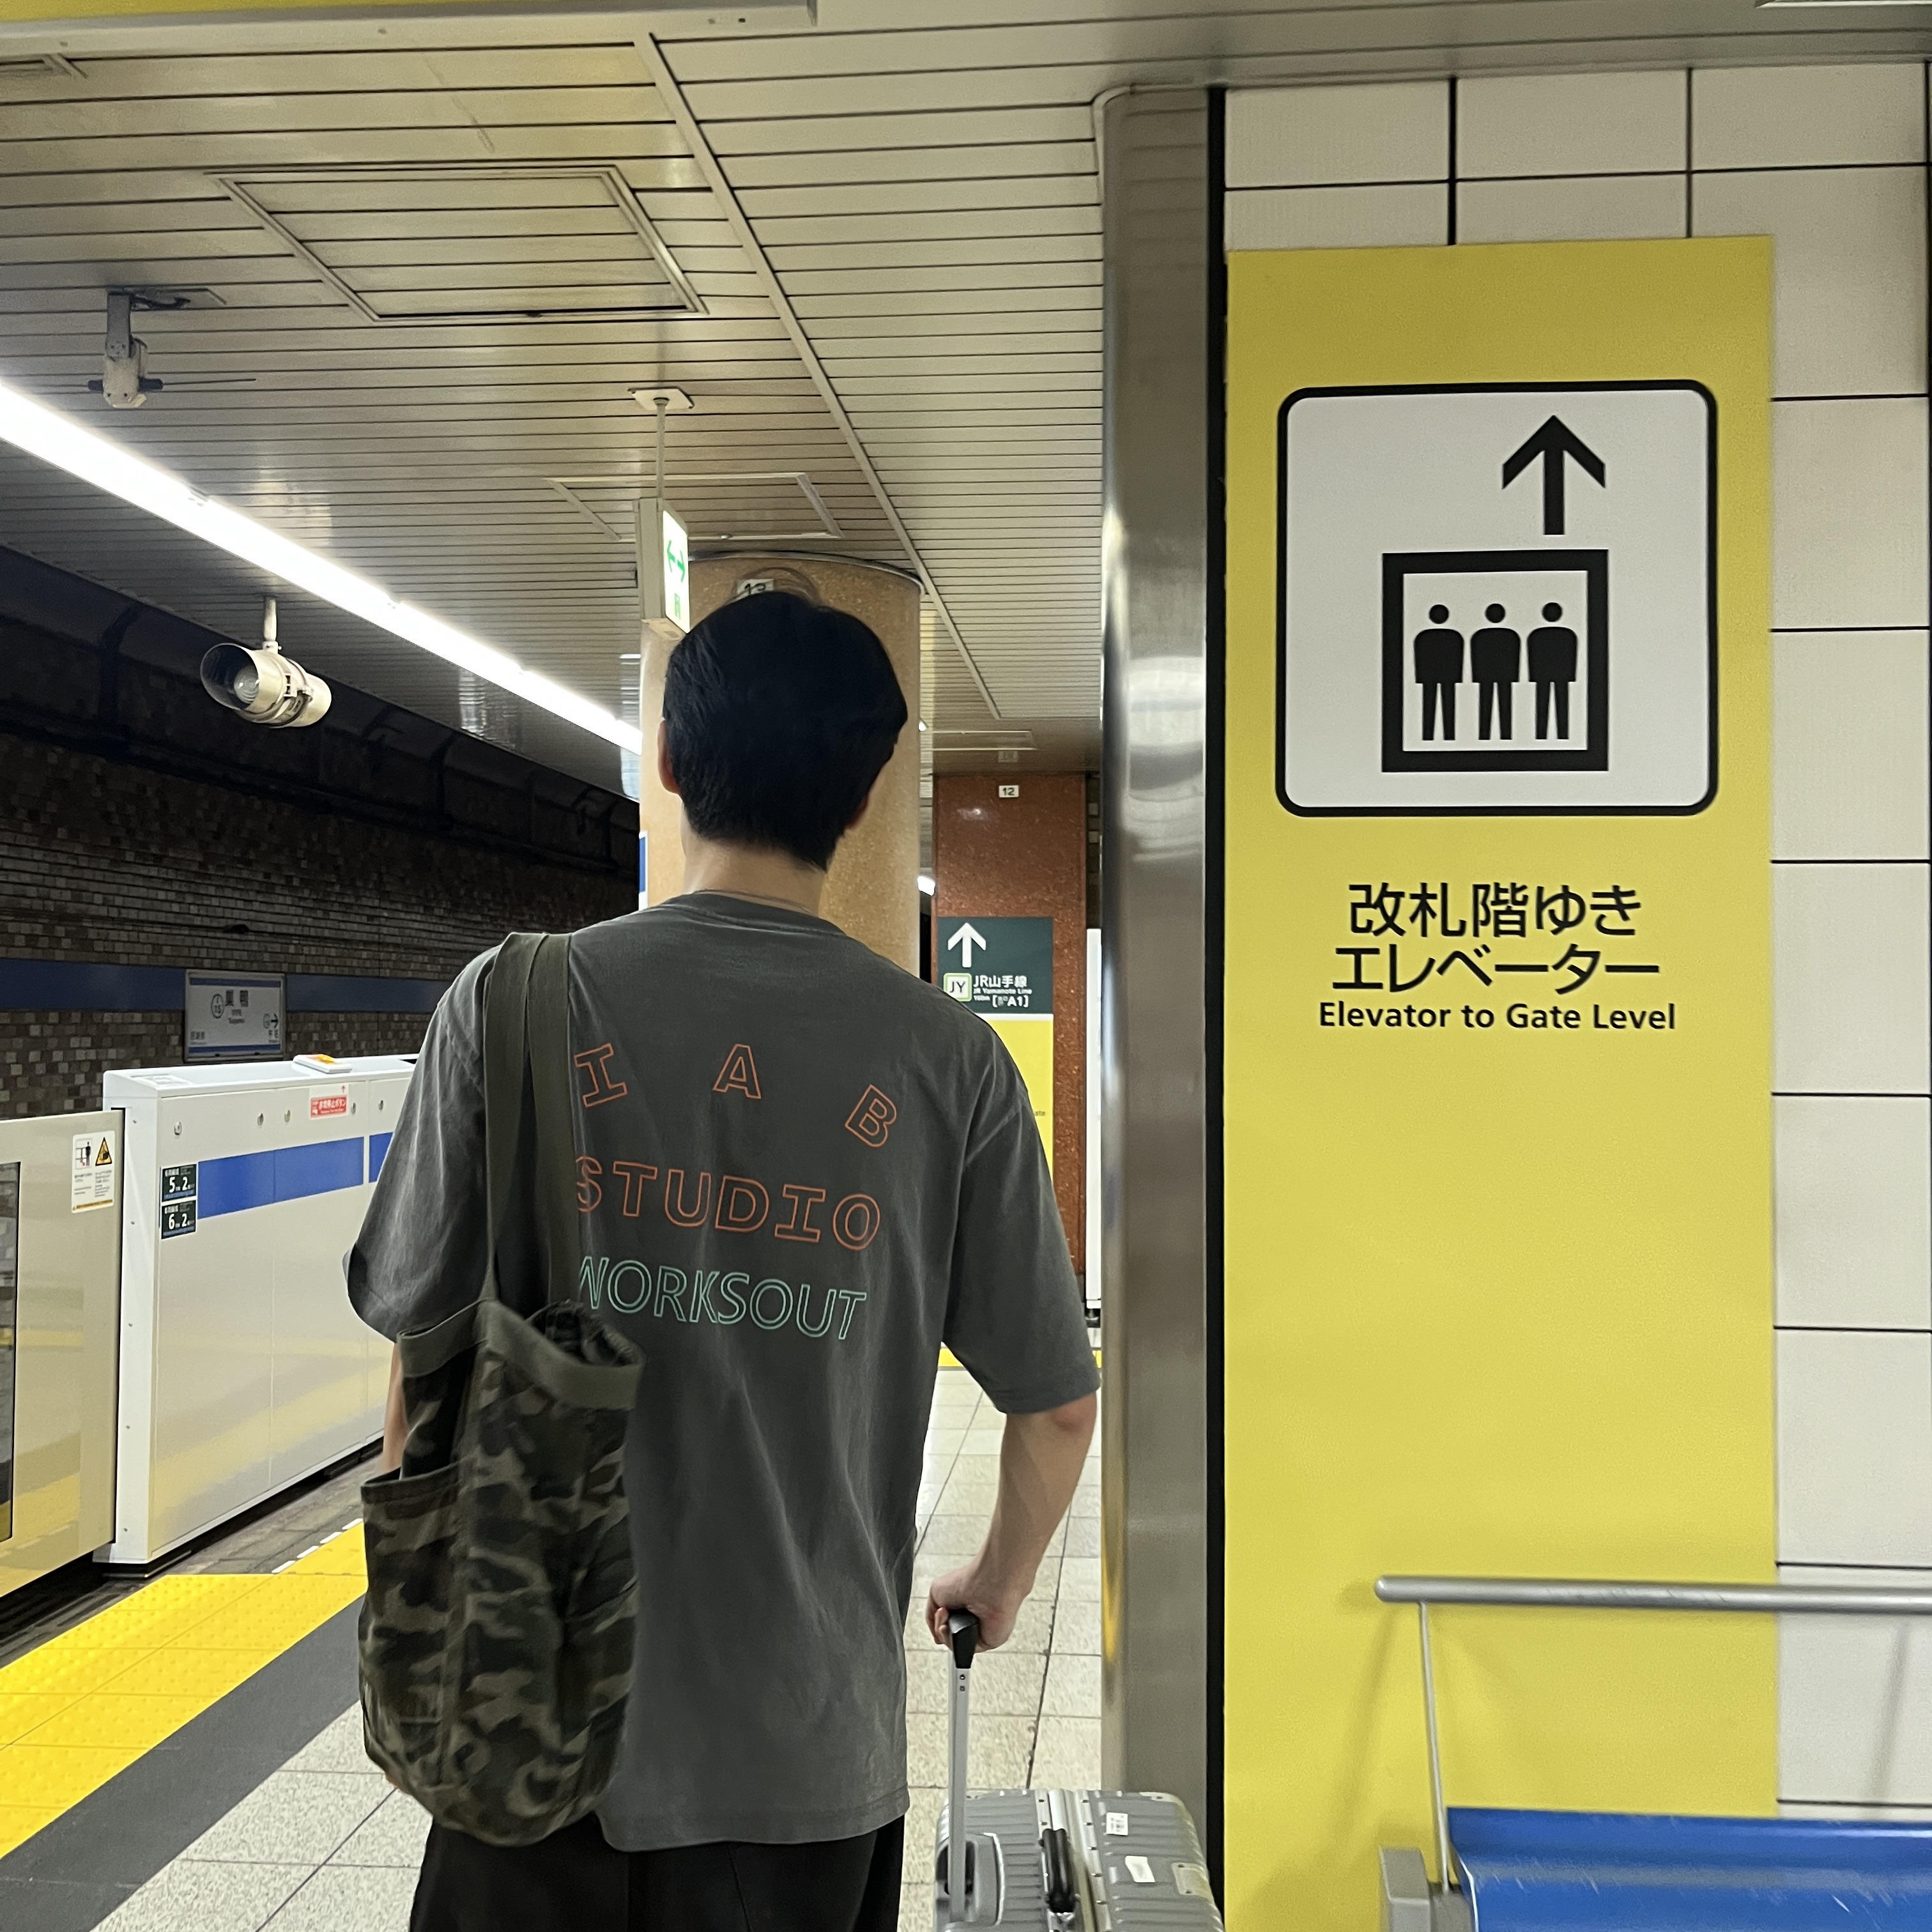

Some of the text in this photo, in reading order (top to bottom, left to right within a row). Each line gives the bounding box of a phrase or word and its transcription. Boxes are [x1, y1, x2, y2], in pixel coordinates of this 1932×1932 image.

[1002, 787, 1015, 796] 12
[1348, 882, 1641, 938] 改札階ゆき
[1332, 943, 1660, 995] エレベーター
[949, 981, 966, 993] JY
[1320, 1001, 1675, 1030] Elevator to Gate Level
[169, 1176, 188, 1193] 5 2
[575, 1155, 880, 1251] STUDIO
[168, 1213, 187, 1229] 6 2
